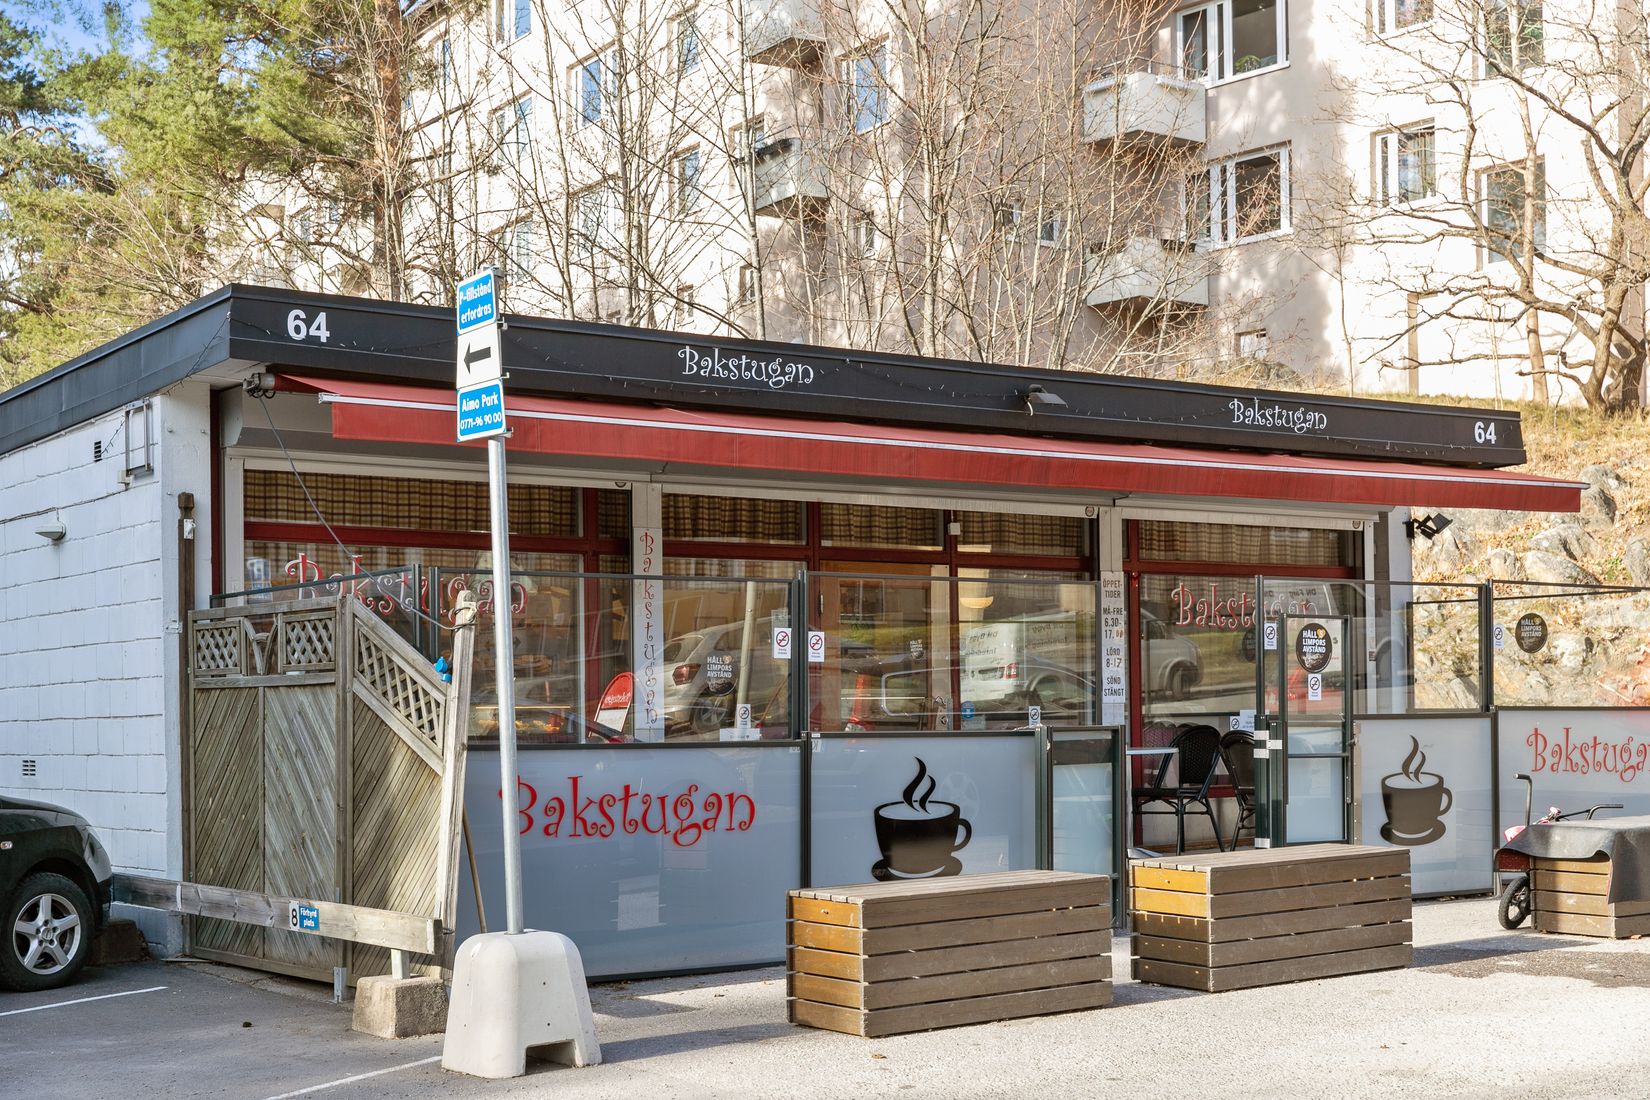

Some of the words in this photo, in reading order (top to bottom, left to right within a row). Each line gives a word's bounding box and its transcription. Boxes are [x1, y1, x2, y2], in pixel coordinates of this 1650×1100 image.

[459, 279, 492, 306] P-tillstånd
[460, 303, 492, 324] erfordras
[287, 309, 330, 343] 64
[677, 345, 814, 389] Bakstugan
[462, 398, 480, 413] Aimo
[481, 392, 499, 407] Park
[483, 413, 493, 426] 90
[492, 411, 502, 424] 00
[1229, 397, 1327, 434] Bakstugan
[1473, 421, 1497, 444] 64
[1102, 579, 1123, 588] ÖPPET-
[1105, 590, 1121, 599] TIDER
[1102, 606, 1123, 616] MÅ-FRE
[1104, 617, 1122, 627] 6.30-
[1302, 629, 1318, 639] HÅLL
[1302, 638, 1326, 647] LIMPORS
[1106, 647, 1121, 656] LÖRD
[1302, 645, 1326, 653] AVSTÅND
[707, 655, 724, 664] HÅLL
[707, 663, 733, 672] LIMPORS
[706, 670, 733, 678] AVSTÅND
[1106, 676, 1121, 685] SÖND
[1526, 727, 1650, 783] Bakstuga
[497, 775, 757, 847] Bakstugan
[291, 907, 298, 927] 8
